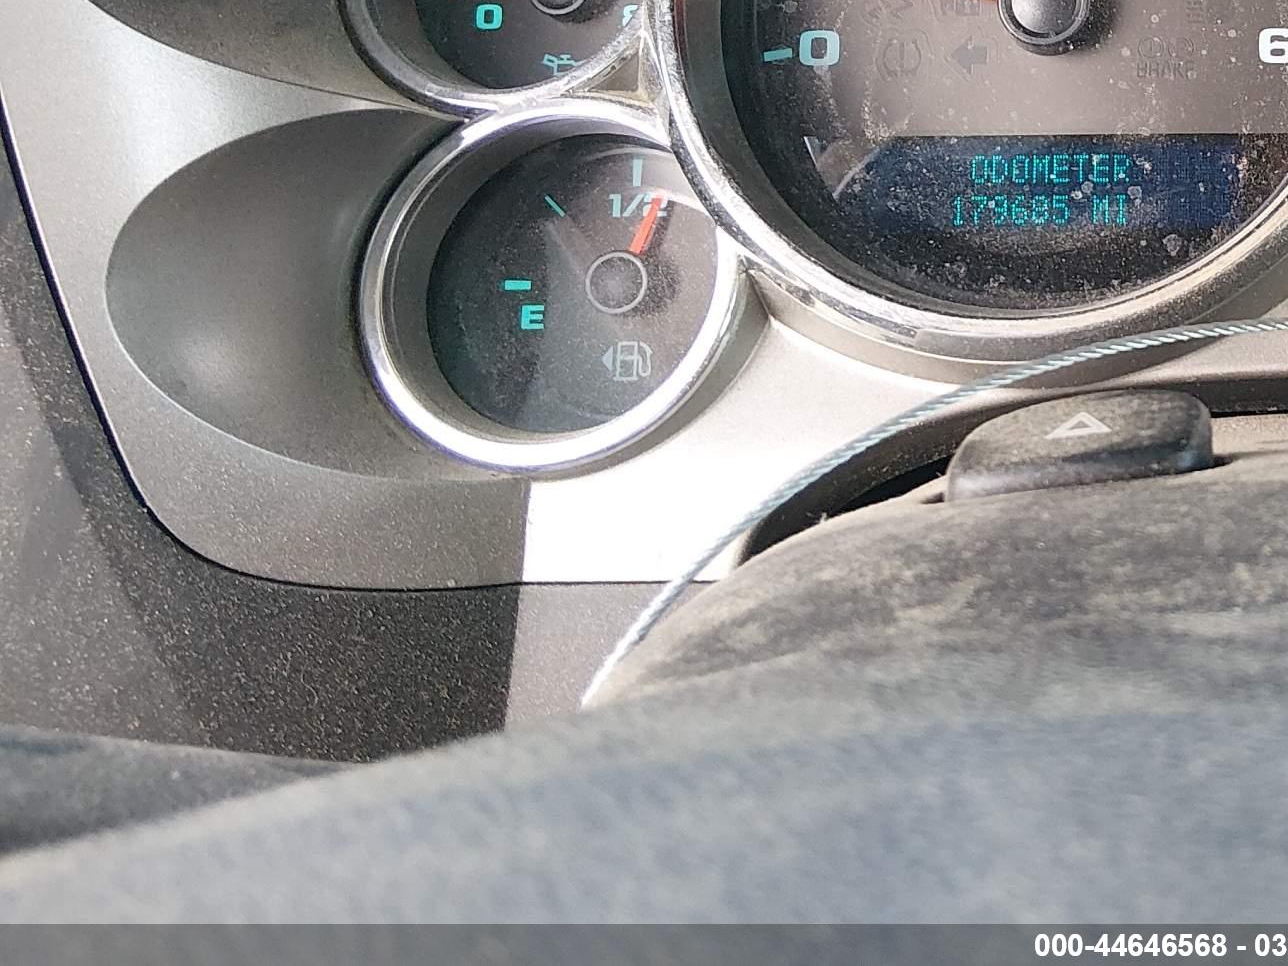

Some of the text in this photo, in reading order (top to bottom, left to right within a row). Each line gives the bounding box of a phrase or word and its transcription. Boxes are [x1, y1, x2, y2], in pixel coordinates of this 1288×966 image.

[476, 4, 502, 29] 0
[799, 29, 840, 66] 0
[970, 153, 1131, 184] ODOMETER
[1093, 195, 1128, 226] MI
[521, 305, 544, 329] E
